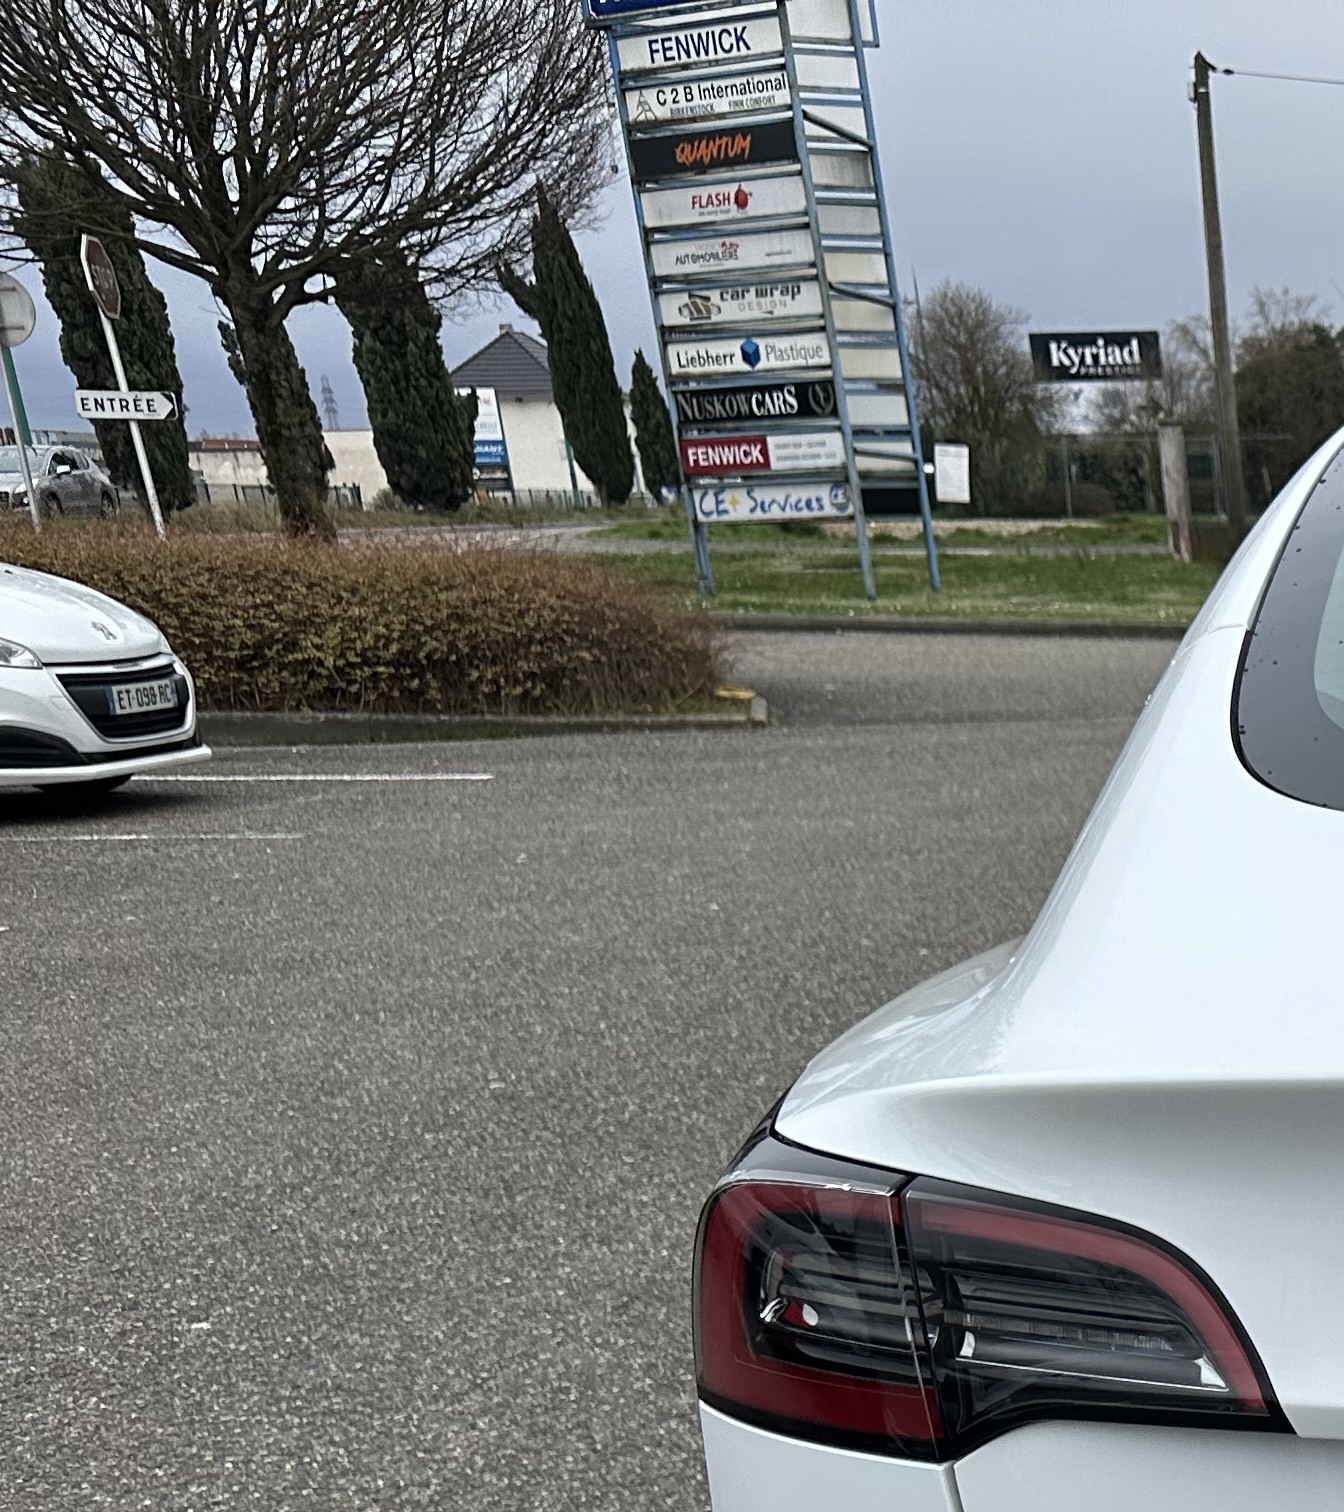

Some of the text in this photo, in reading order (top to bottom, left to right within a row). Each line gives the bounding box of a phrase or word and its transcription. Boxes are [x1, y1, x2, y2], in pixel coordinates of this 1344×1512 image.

[648, 26, 751, 64] FENWICK
[656, 73, 787, 107] C 2 B International
[675, 131, 751, 166] QUANTUM
[691, 192, 730, 210] FLASH
[720, 286, 750, 301] car
[677, 343, 823, 369] Liebherr Plastique
[1049, 336, 1141, 374] Kyriad
[80, 394, 157, 413] ENTRÉE
[688, 443, 765, 467] FENWICK
[747, 487, 824, 514] Services
